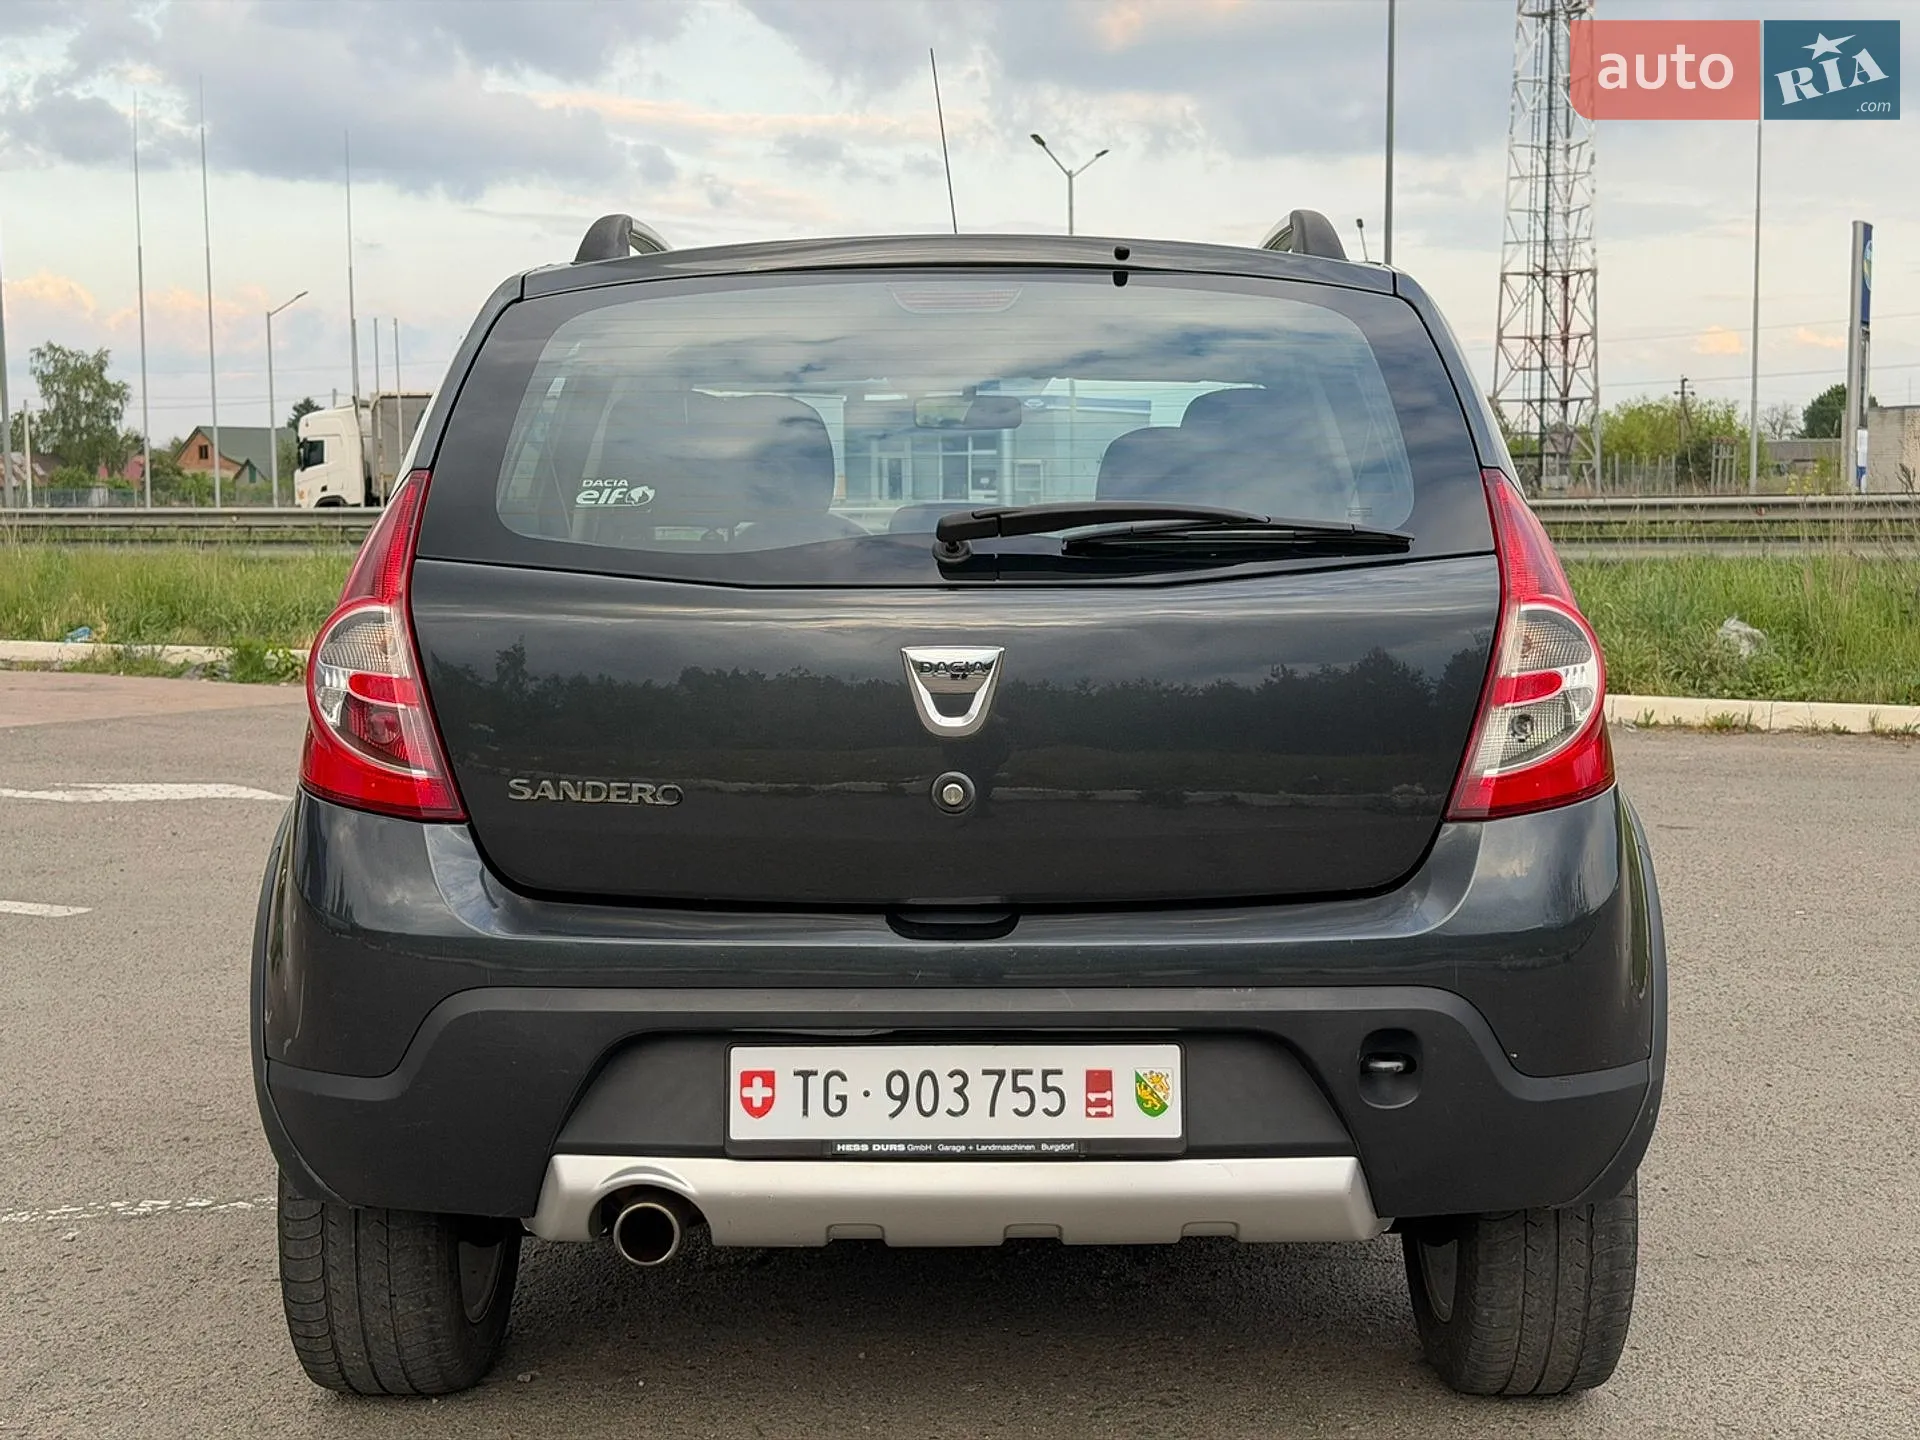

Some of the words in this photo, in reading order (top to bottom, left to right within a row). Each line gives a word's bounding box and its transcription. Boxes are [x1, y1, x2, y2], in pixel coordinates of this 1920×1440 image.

[576, 488, 628, 505] elf
[508, 778, 685, 807] SANDERO
[837, 1143, 869, 1152] HESS
[872, 1143, 906, 1152] DURS
[907, 1143, 932, 1152] GmbH
[937, 1143, 966, 1153] Garage
[976, 1143, 1036, 1152] Landmaschinen
[1041, 1142, 1075, 1152] Burgdorf
